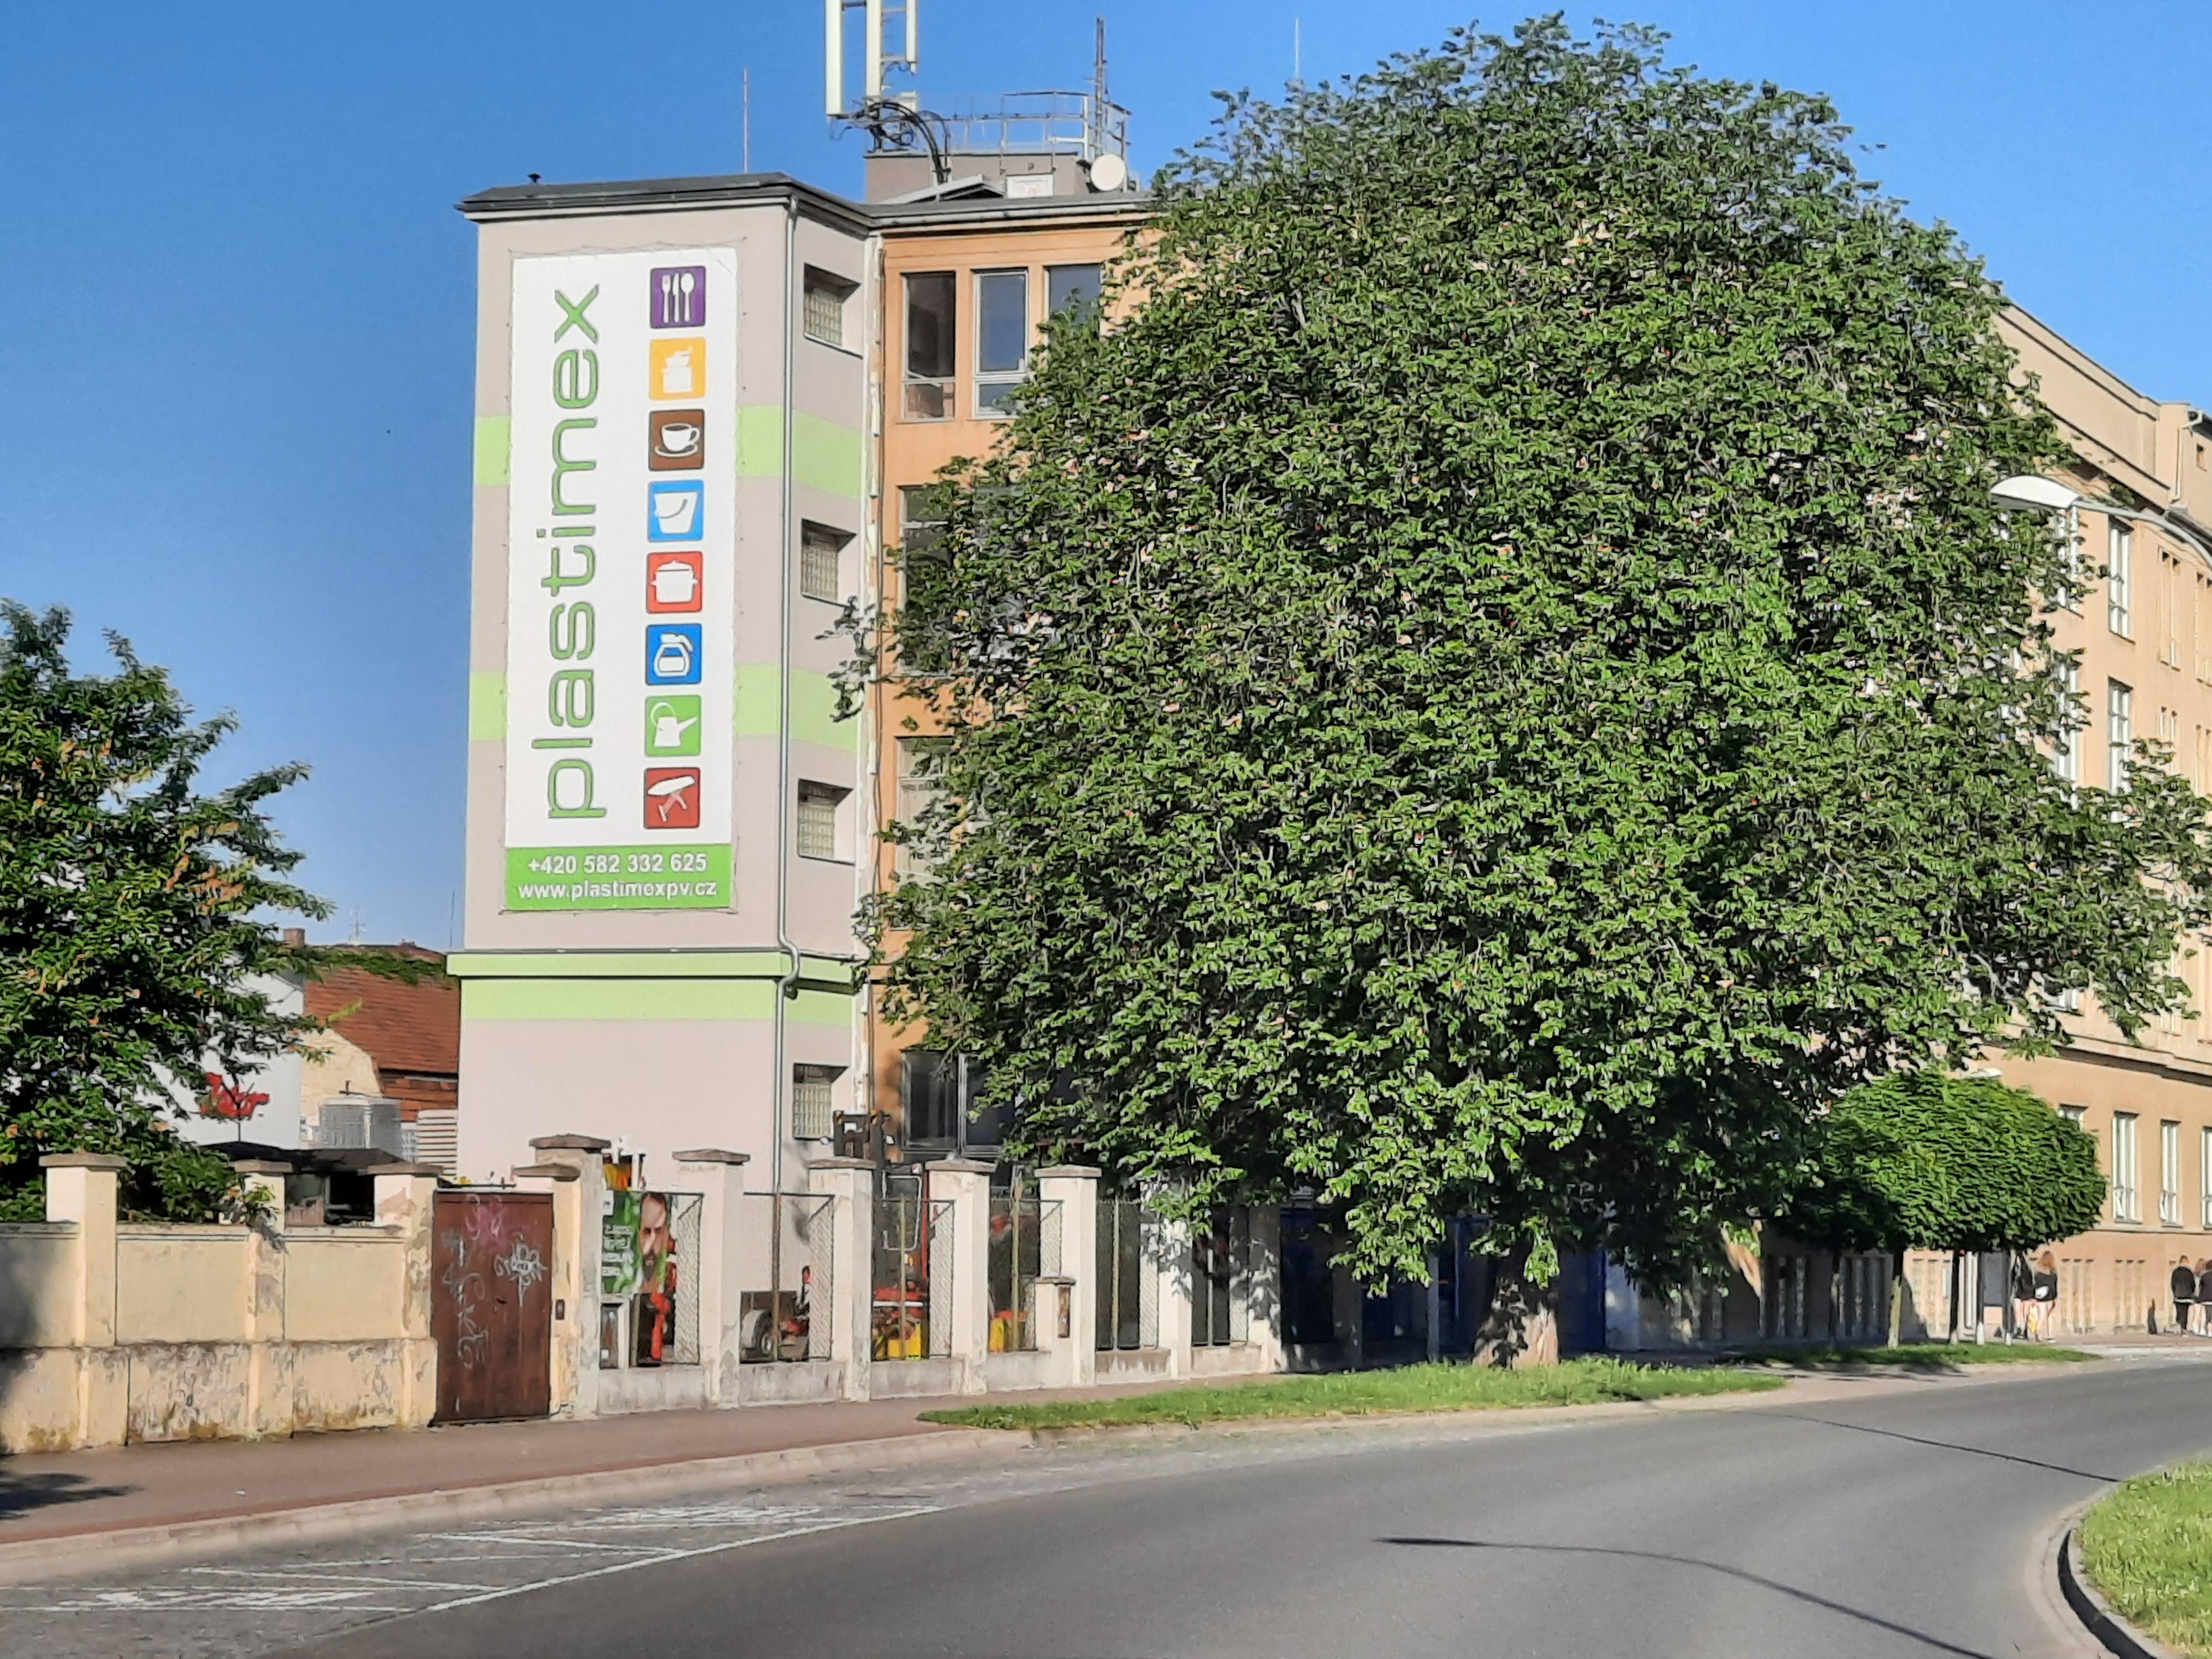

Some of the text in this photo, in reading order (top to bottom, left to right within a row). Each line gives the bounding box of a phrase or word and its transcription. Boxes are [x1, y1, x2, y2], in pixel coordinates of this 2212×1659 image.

[531, 284, 607, 819] plastimex
[528, 853, 707, 874] +420 582 332 625
